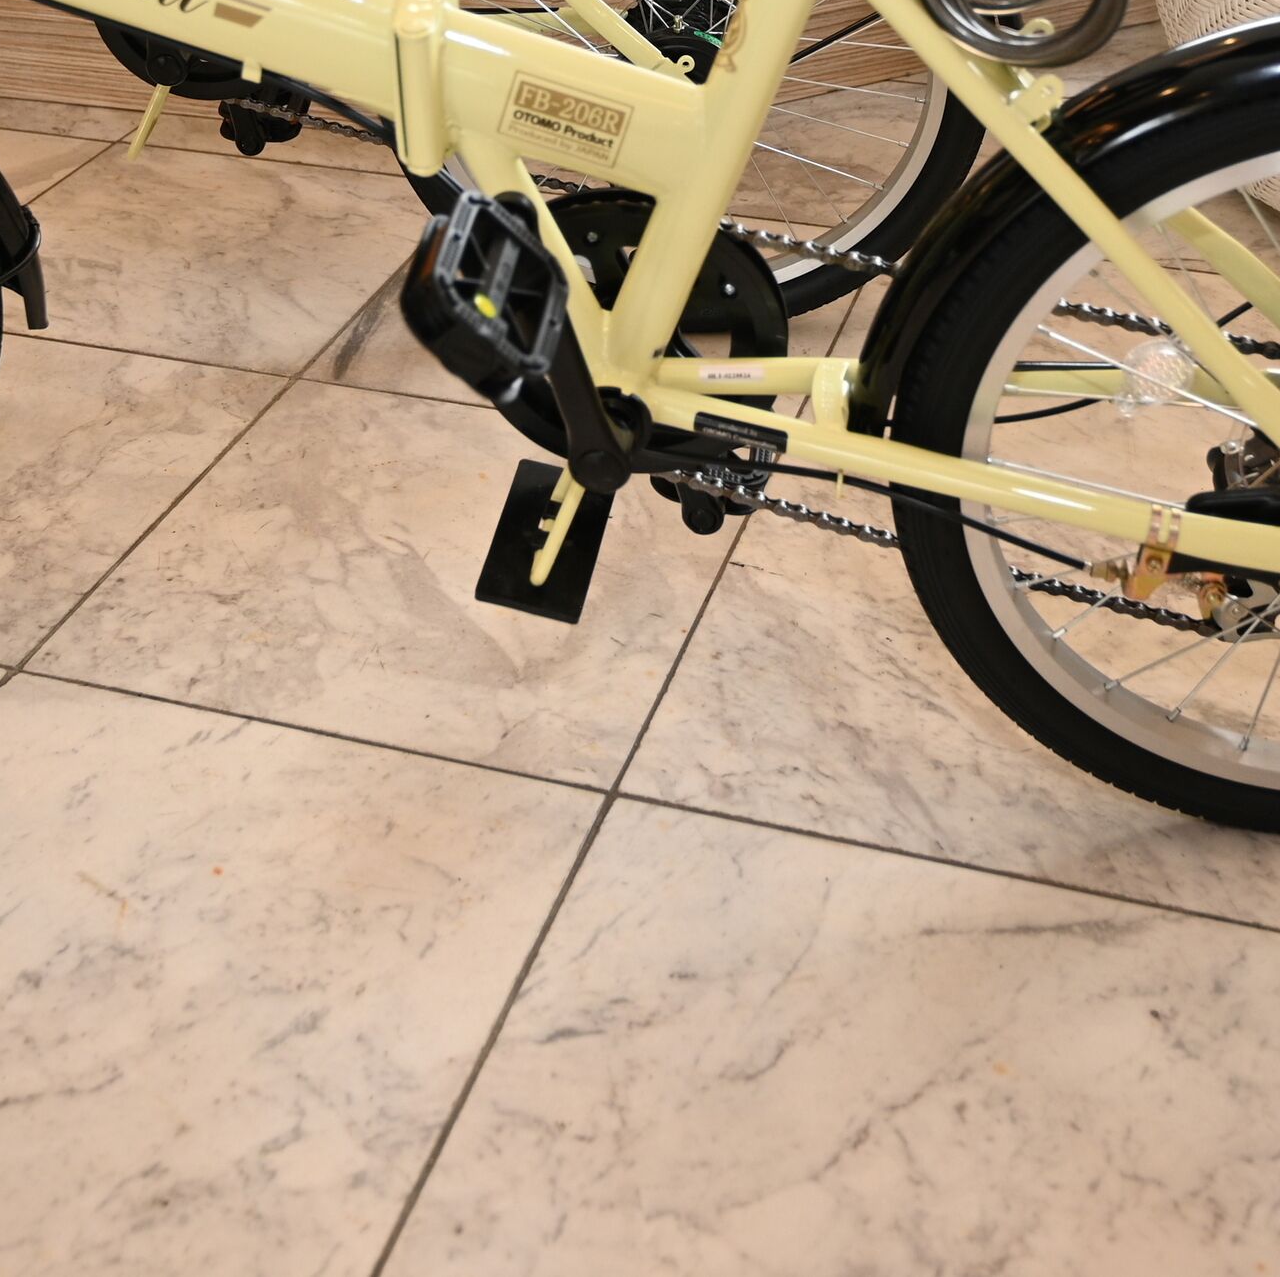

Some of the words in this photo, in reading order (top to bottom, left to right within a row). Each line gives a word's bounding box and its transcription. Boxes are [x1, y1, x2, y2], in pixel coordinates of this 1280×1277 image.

[513, 109, 562, 132] OTOMO
[563, 124, 614, 148] Product
[518, 84, 620, 134] FB-206R
